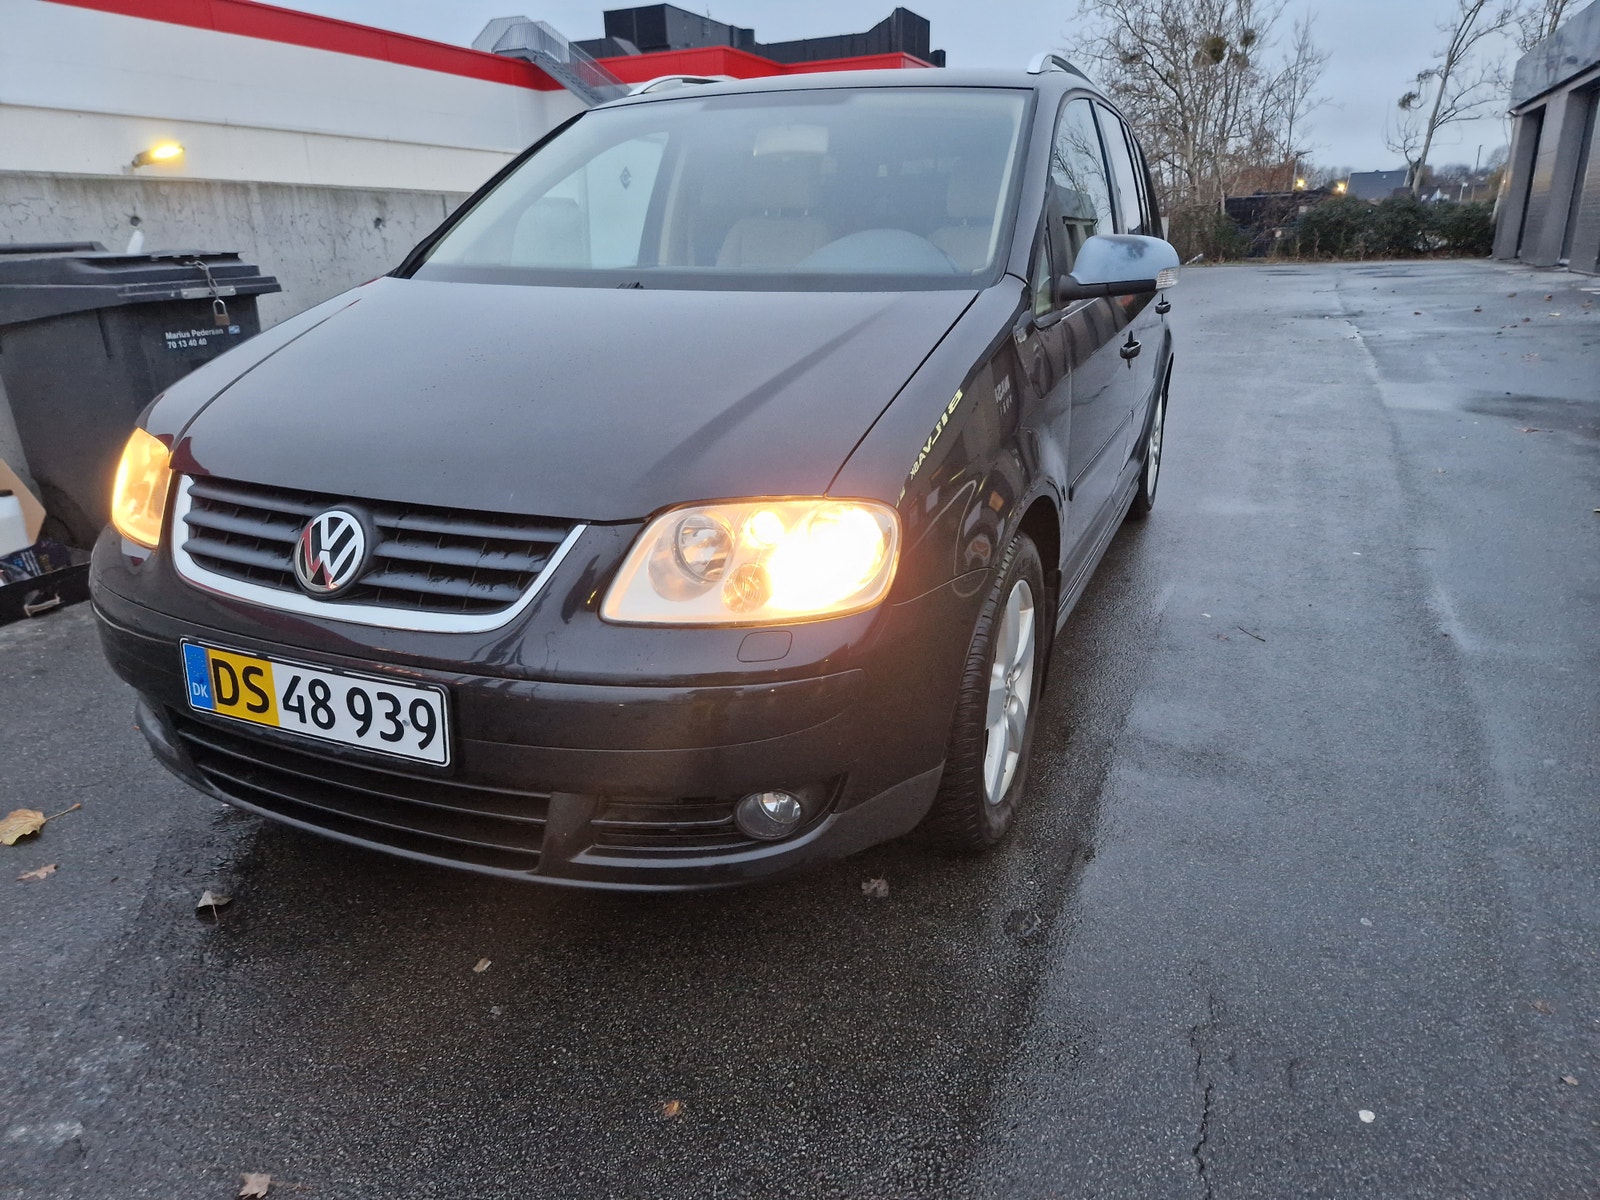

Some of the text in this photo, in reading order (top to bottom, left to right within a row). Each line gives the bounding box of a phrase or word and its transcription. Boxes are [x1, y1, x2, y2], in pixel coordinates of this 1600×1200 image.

[165, 328, 224, 340] Marius Pedersen
[167, 338, 208, 349] 70 13 40 40
[296, 510, 364, 592] VW
[192, 682, 208, 698] DK
[211, 658, 437, 750] DS 48 939
